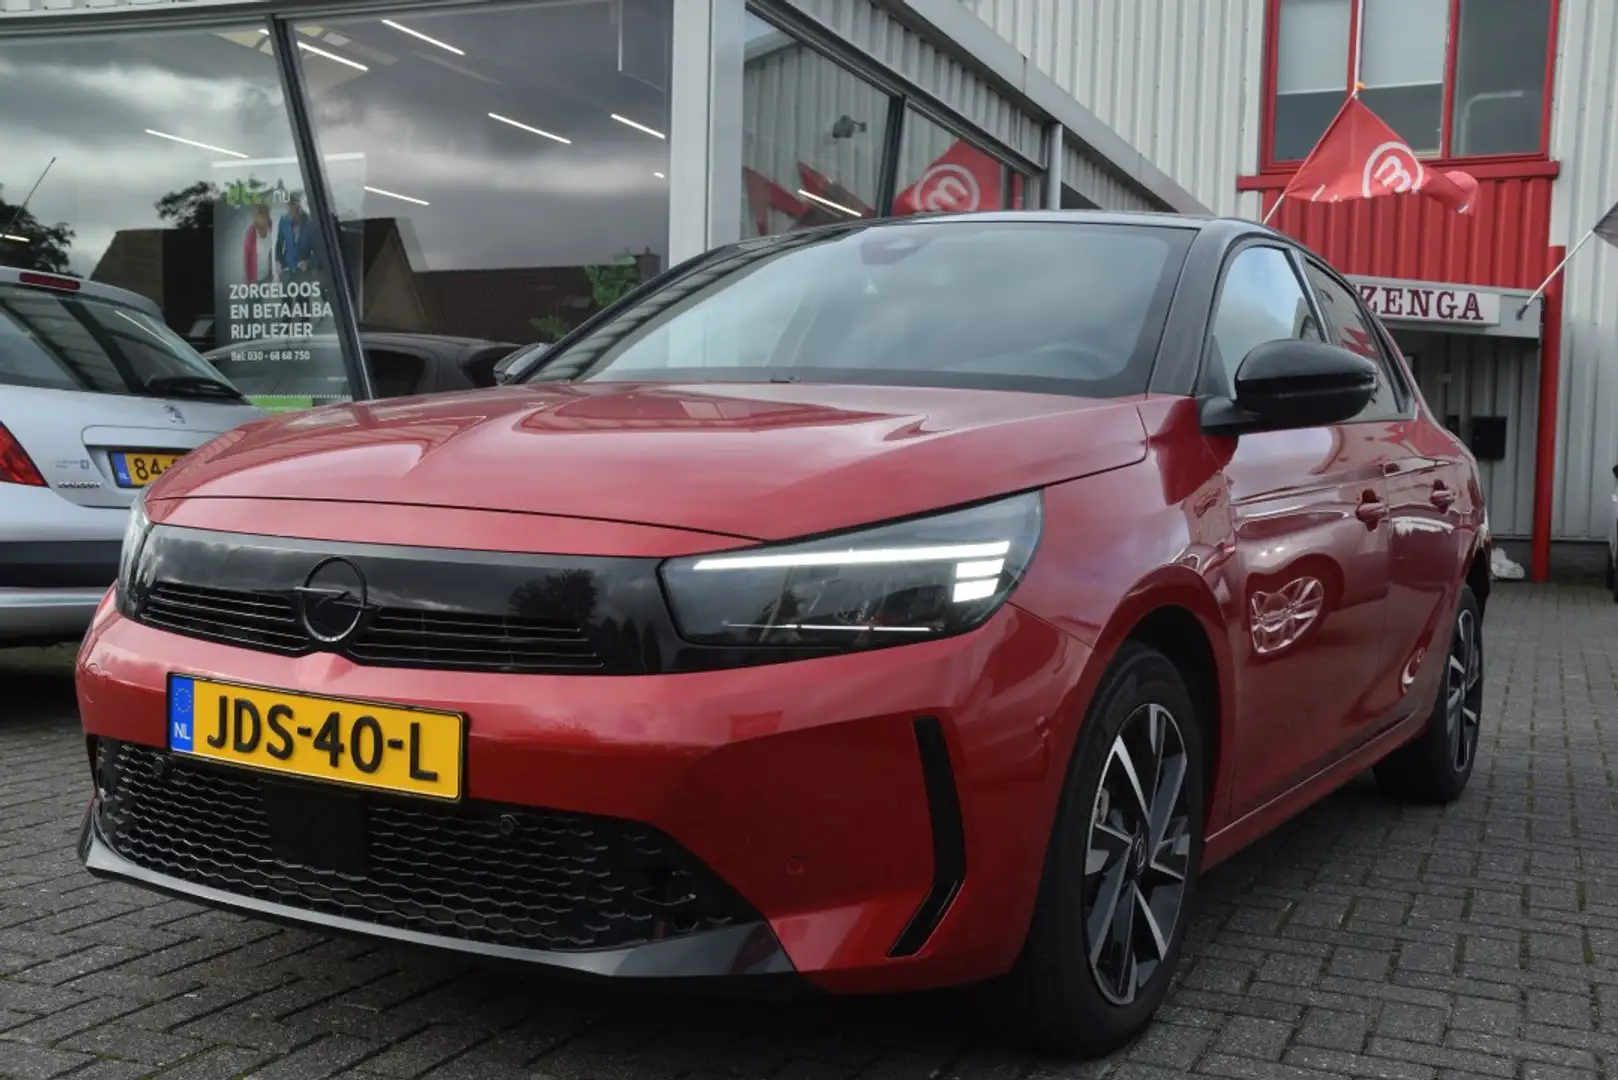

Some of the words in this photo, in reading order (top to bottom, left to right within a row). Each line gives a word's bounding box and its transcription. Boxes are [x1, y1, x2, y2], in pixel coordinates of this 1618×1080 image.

[229, 281, 321, 300] ZORGELOOS
[230, 304, 249, 319] EN
[253, 302, 334, 319] BETAALBA
[1355, 285, 1484, 321] ZENGA
[230, 322, 313, 339] RIJPLEZIER
[247, 350, 264, 361] 030
[269, 351, 280, 361] 68
[282, 350, 293, 361] 68
[294, 350, 310, 360] 750
[133, 457, 178, 481] 84-
[173, 721, 192, 736] NL
[207, 695, 438, 782] JDS-40-L
